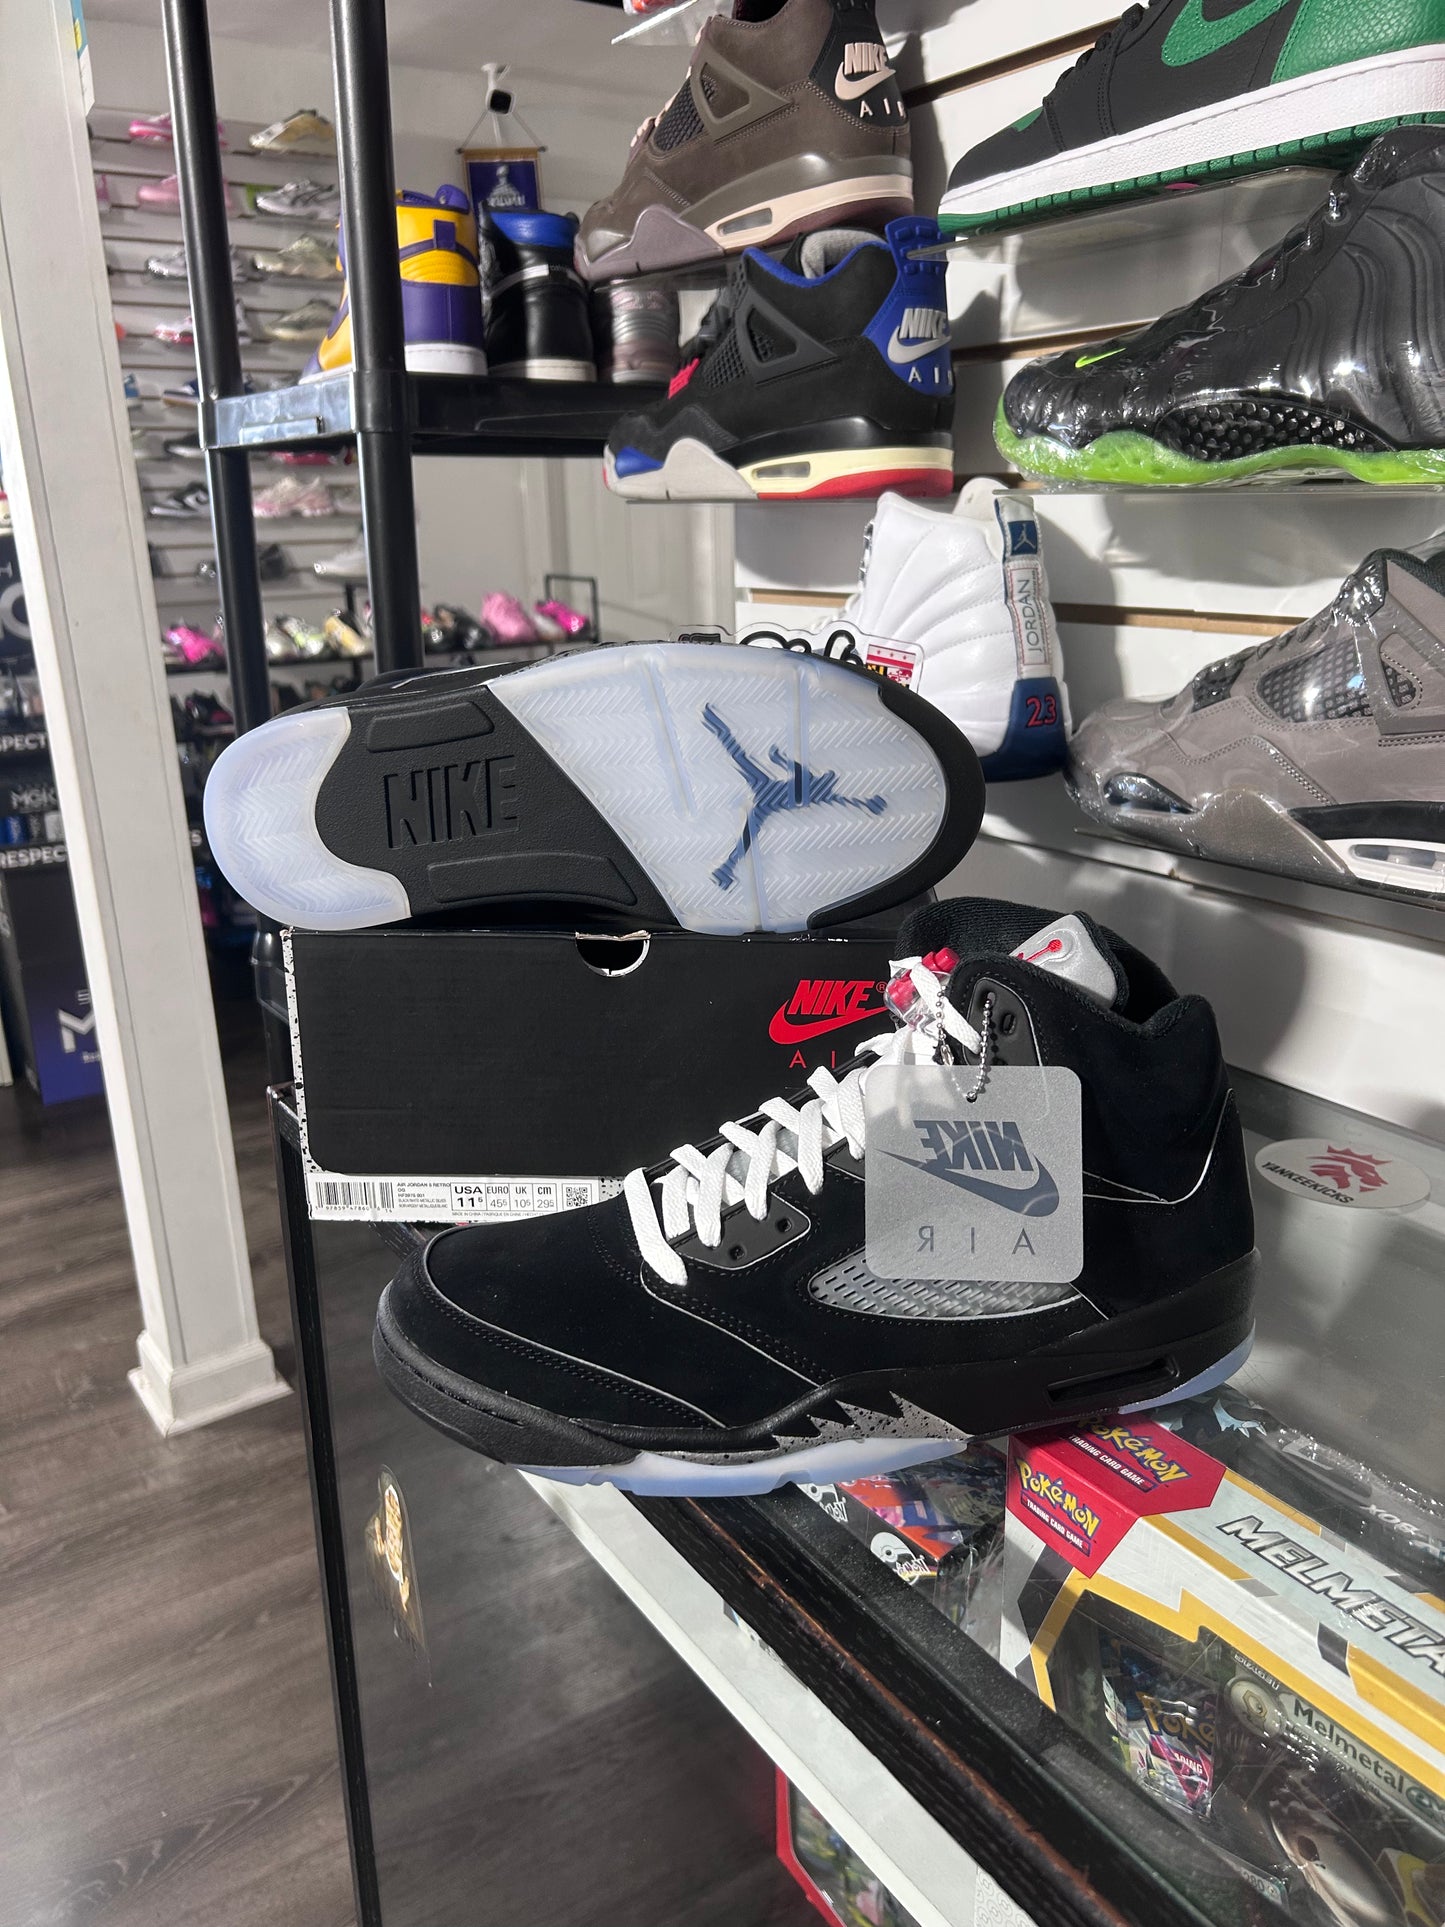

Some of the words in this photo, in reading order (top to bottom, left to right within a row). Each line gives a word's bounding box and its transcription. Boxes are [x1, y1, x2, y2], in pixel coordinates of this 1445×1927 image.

[844, 42, 888, 75] NIKE
[899, 308, 947, 339] NIKE
[1017, 579, 1042, 653] JORDAN
[1026, 695, 1057, 729] 23
[383, 754, 520, 851] NIKE
[786, 979, 877, 1016] NIKE
[454, 1185, 483, 1195] USA
[486, 1185, 509, 1195] EURO
[515, 1185, 527, 1195] UK
[537, 1186, 552, 1195] cm
[1261, 1161, 1355, 1204] YANKEEKICKS
[1068, 1435, 1100, 1457] TRADING
[1099, 1453, 1121, 1470] CARD
[1120, 1468, 1145, 1485] GAME
[1026, 1498, 1049, 1523] TRADING
[1050, 1518, 1066, 1537] CARD
[1066, 1530, 1084, 1549] GAME
[1215, 1514, 1445, 1677] MELMETA
[1293, 1698, 1405, 1794] Melmetal
